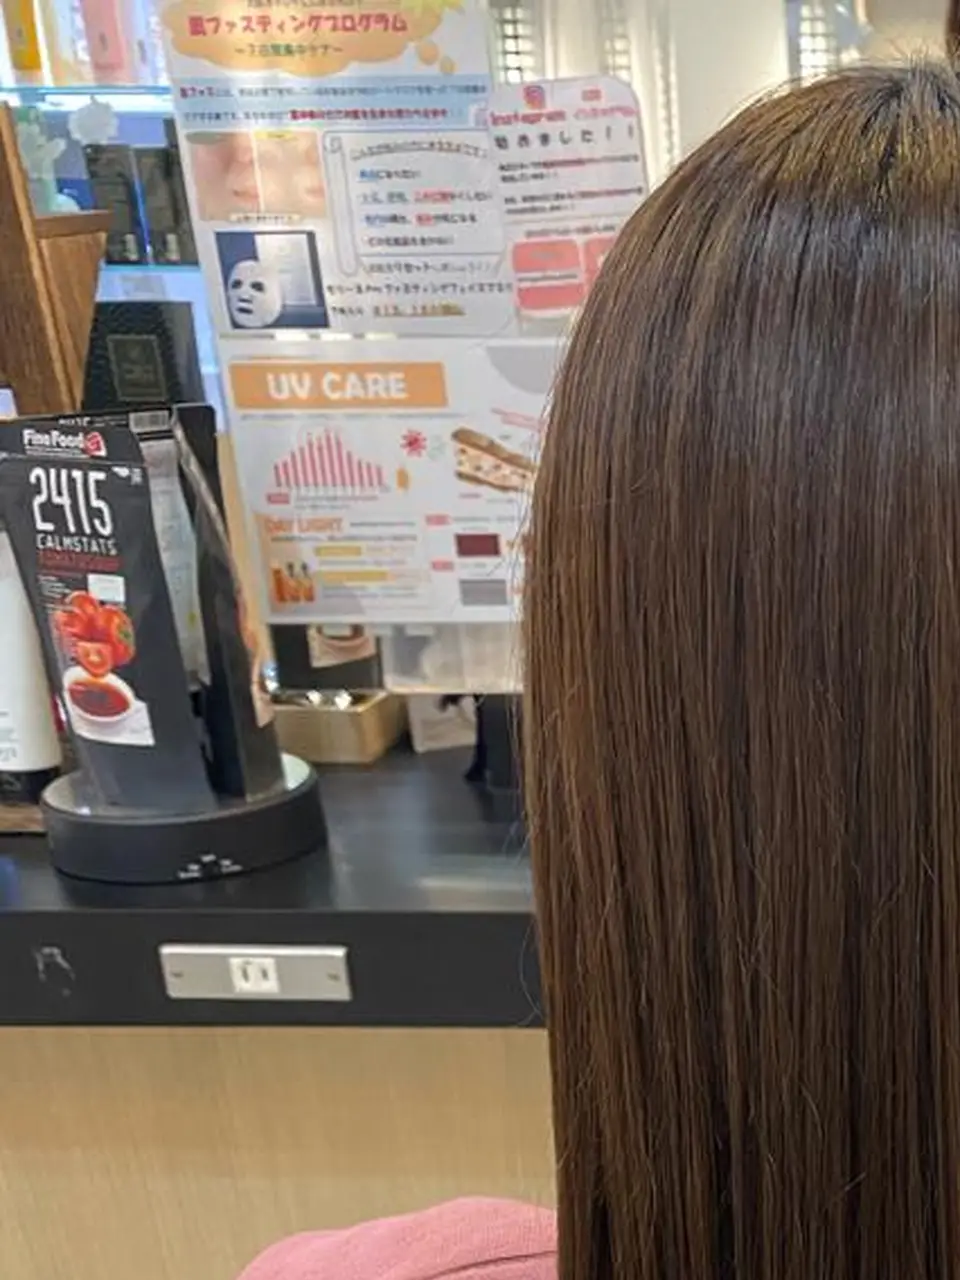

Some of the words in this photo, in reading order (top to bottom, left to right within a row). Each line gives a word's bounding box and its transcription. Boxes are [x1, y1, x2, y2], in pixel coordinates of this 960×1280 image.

[267, 372, 314, 399] UV
[322, 371, 409, 399] CARE
[30, 467, 113, 536] 2415
